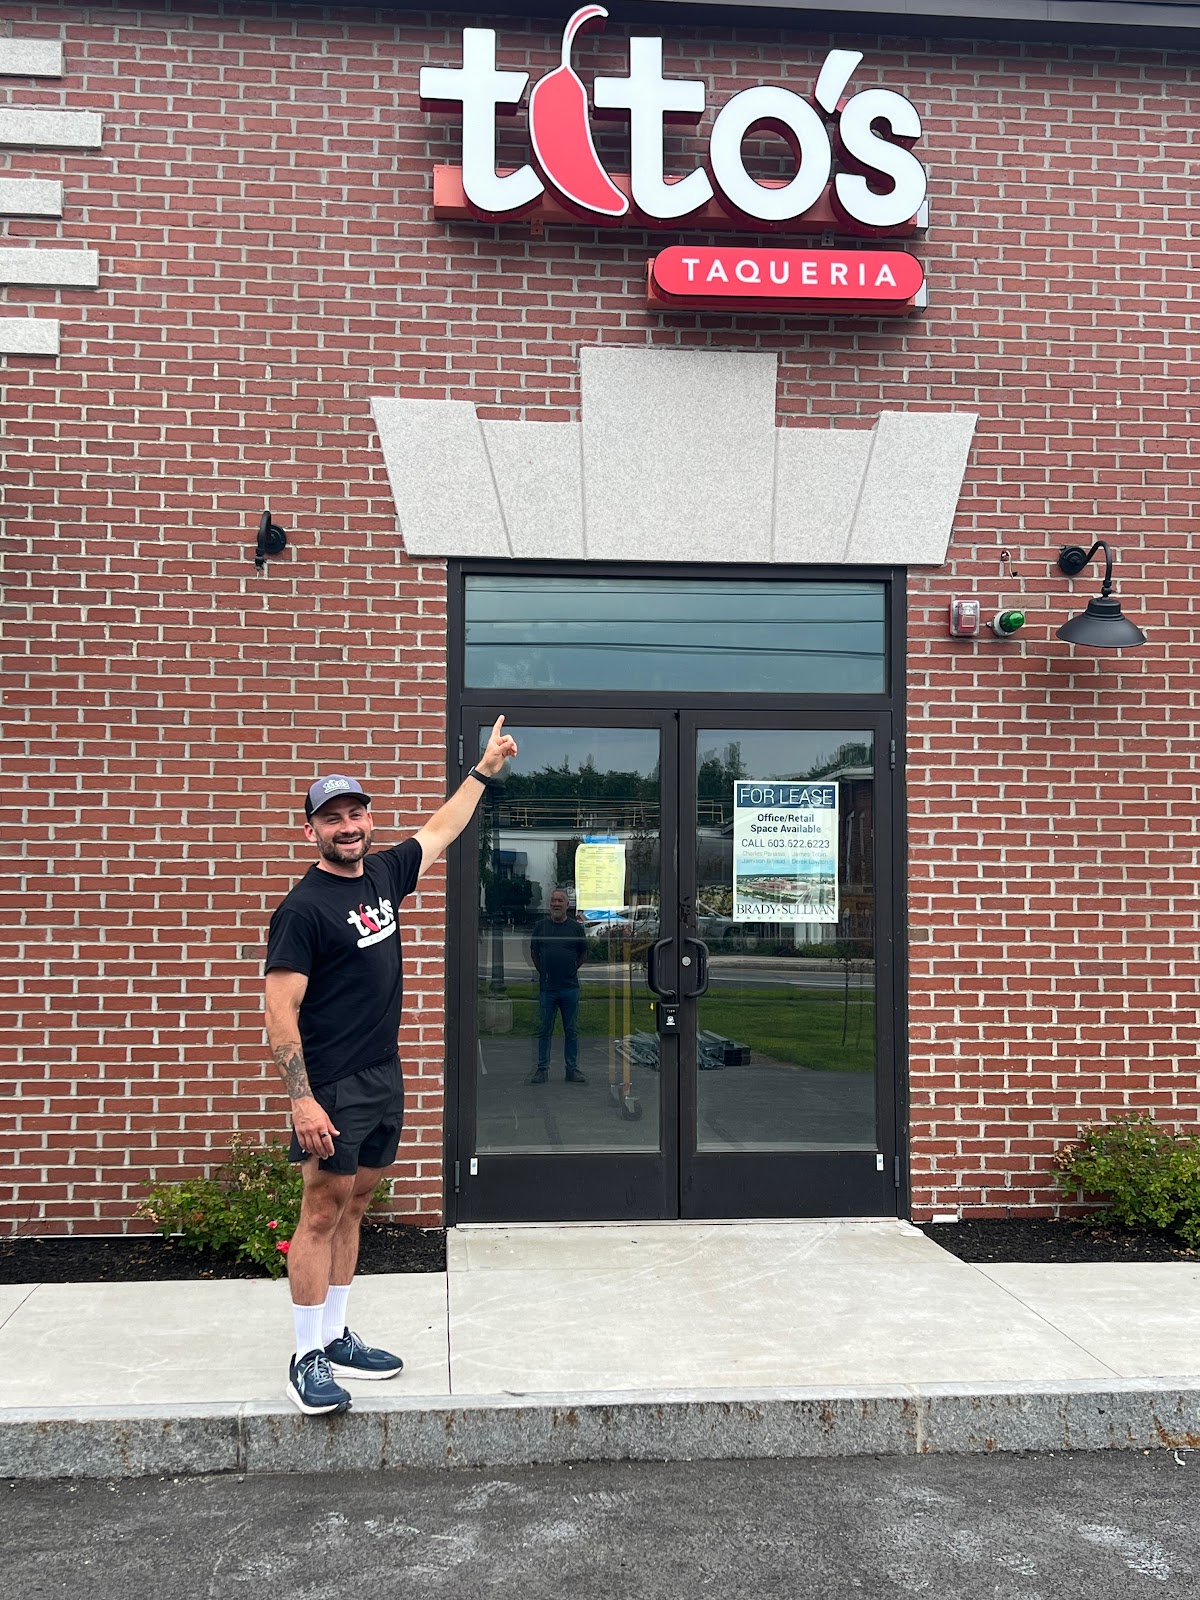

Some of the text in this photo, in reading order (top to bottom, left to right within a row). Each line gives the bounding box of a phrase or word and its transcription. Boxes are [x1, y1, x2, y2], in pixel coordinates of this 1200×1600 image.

[681, 257, 897, 287] TAQUERIA
[740, 788, 833, 805] FOR LEASE
[757, 813, 815, 823] Office/Retail
[750, 824, 821, 834] Space Available
[741, 838, 765, 848] CALL
[736, 903, 835, 915] BRADY SULLIVAN
